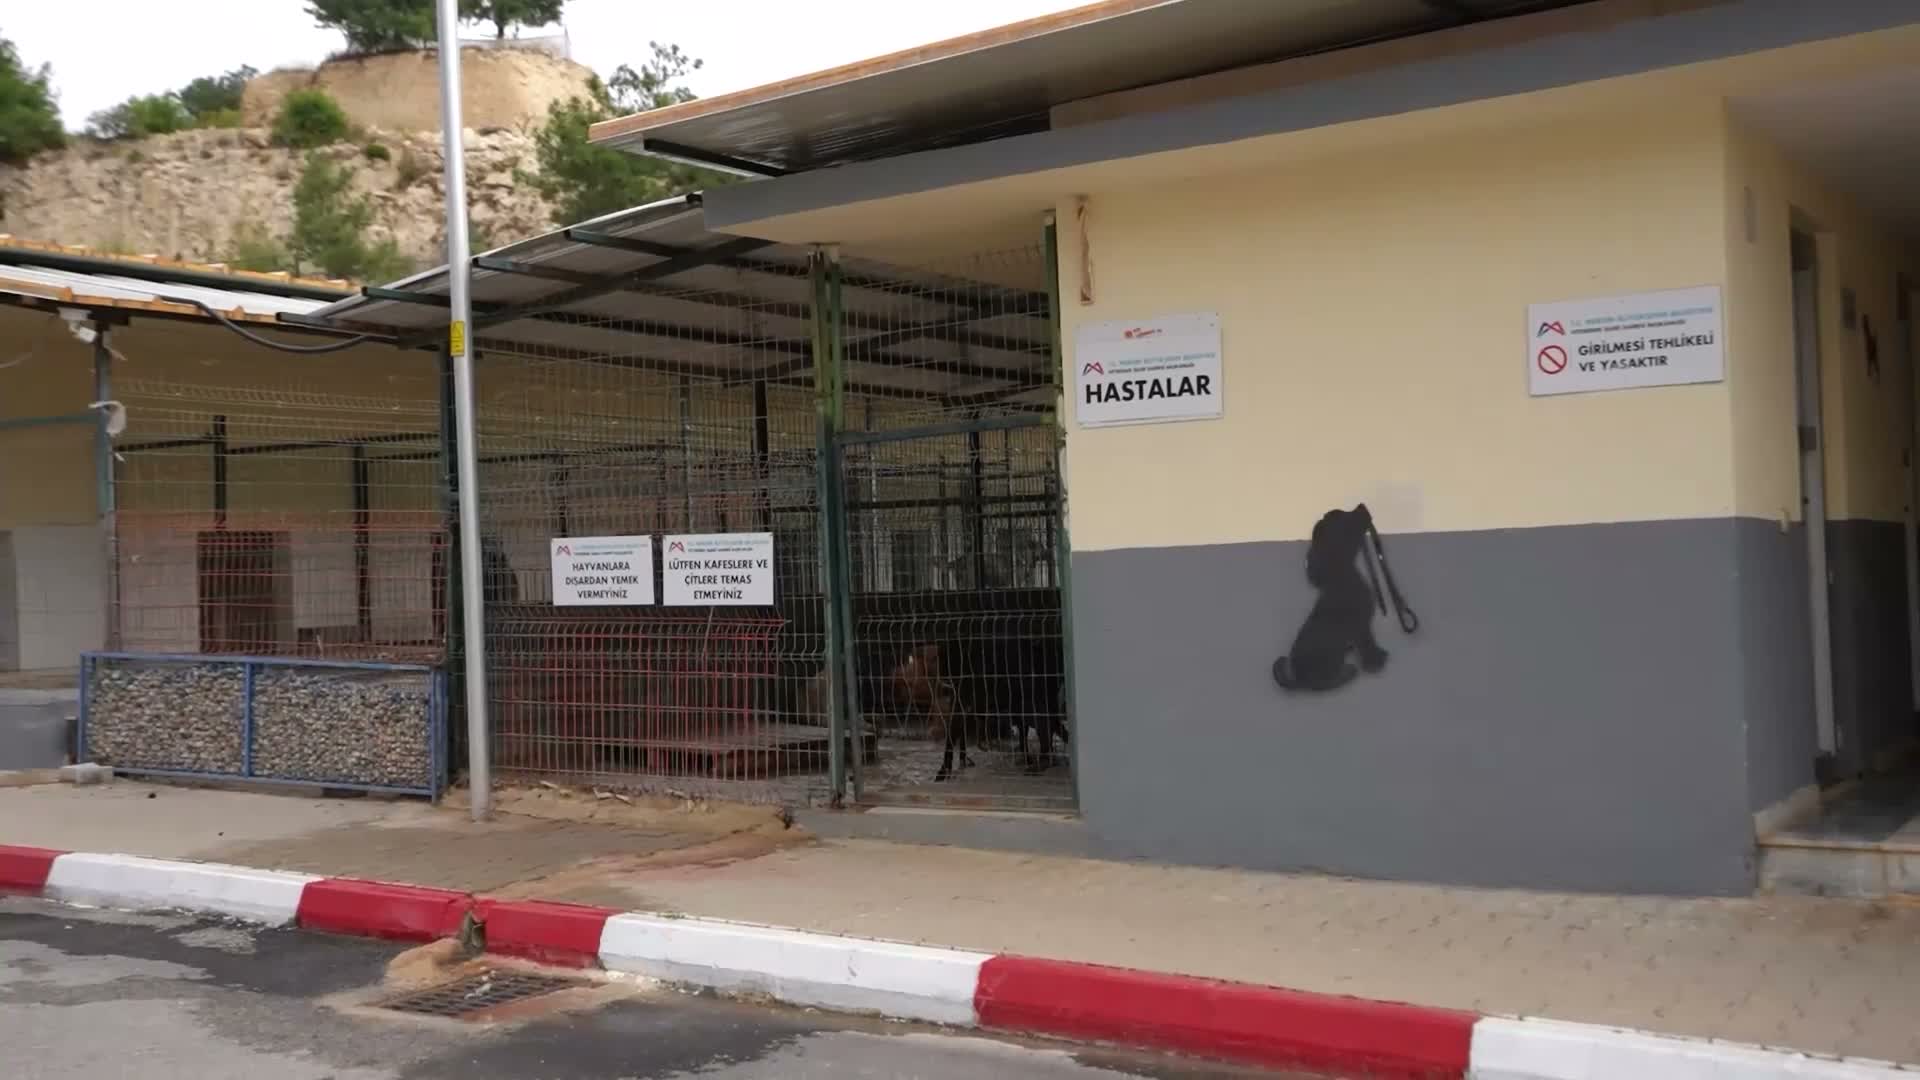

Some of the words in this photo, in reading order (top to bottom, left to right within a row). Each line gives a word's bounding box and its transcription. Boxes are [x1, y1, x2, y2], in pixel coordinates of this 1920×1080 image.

[1578, 337, 1645, 356] GİRİLMESİ
[1650, 331, 1714, 349] TEHLİKELİ
[1579, 361, 1595, 372] VE
[1600, 356, 1668, 371] YASAKTIR
[1086, 375, 1211, 404] HASTALAR
[572, 561, 630, 571] HAYVANLARA
[669, 558, 701, 570] LÜTFEN
[704, 560, 753, 569] KAFESLERE
[756, 559, 768, 569] VE
[611, 575, 639, 585] YEMEK
[684, 573, 718, 586] ÇİTLERE
[721, 575, 752, 585] TEMAS
[577, 587, 628, 599] VERMEYİNİZ
[694, 587, 743, 600] ETMEYİNİZ
